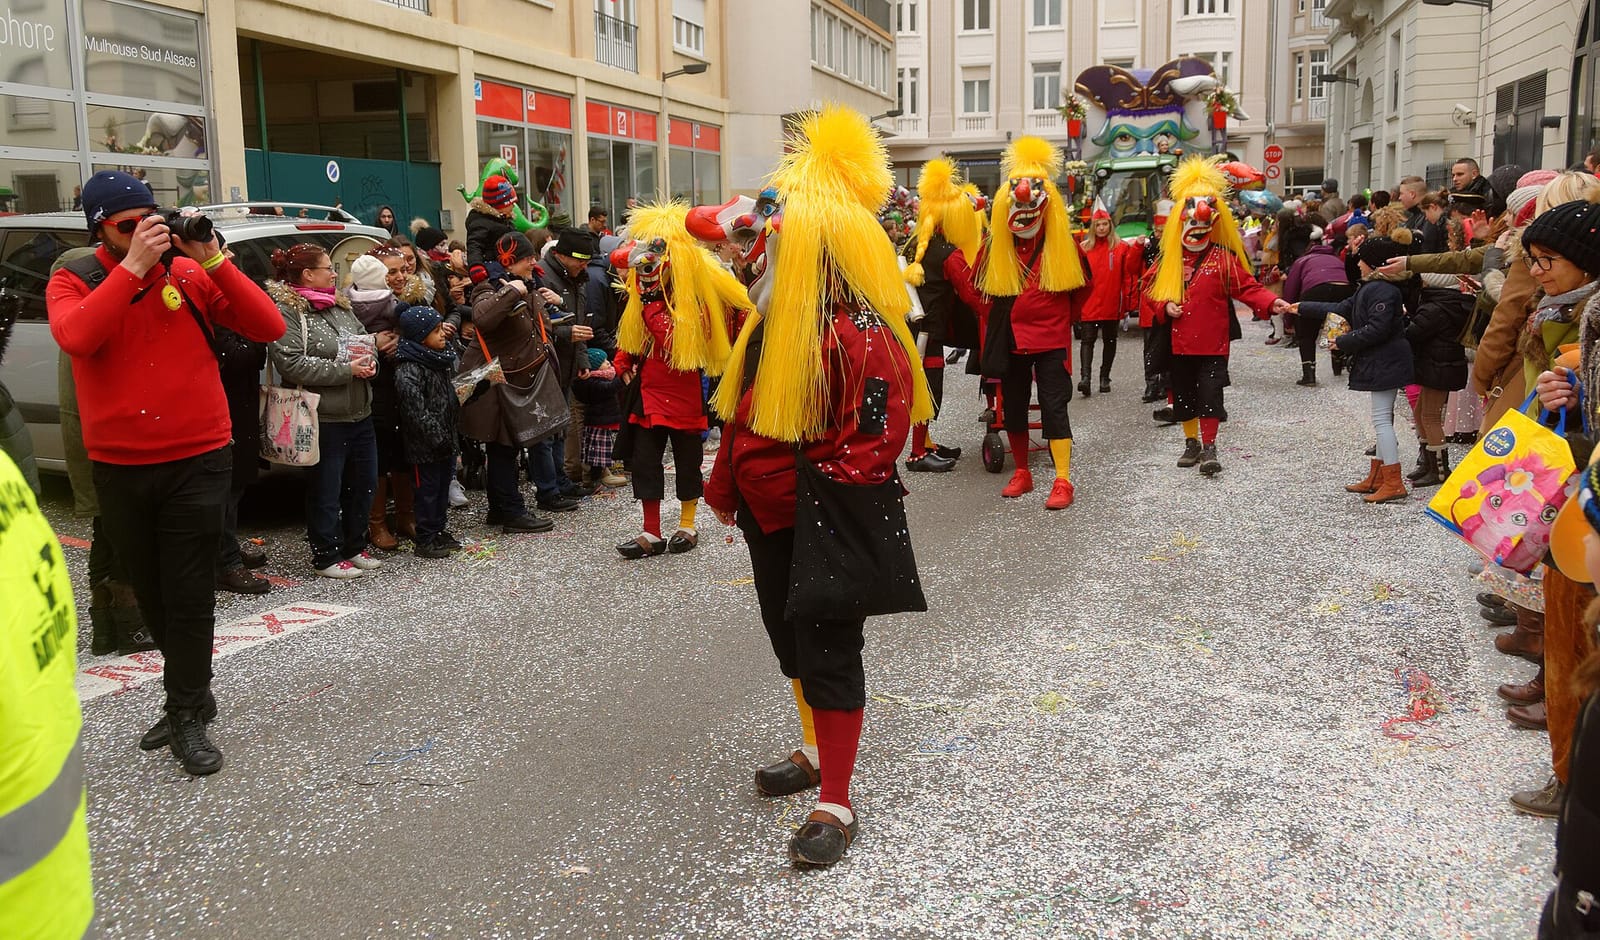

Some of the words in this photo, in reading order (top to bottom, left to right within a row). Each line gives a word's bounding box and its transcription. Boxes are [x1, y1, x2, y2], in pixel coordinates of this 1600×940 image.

[84, 35, 138, 58] Mulhouse
[140, 45, 161, 62] Sud
[163, 49, 196, 68] Alsace
